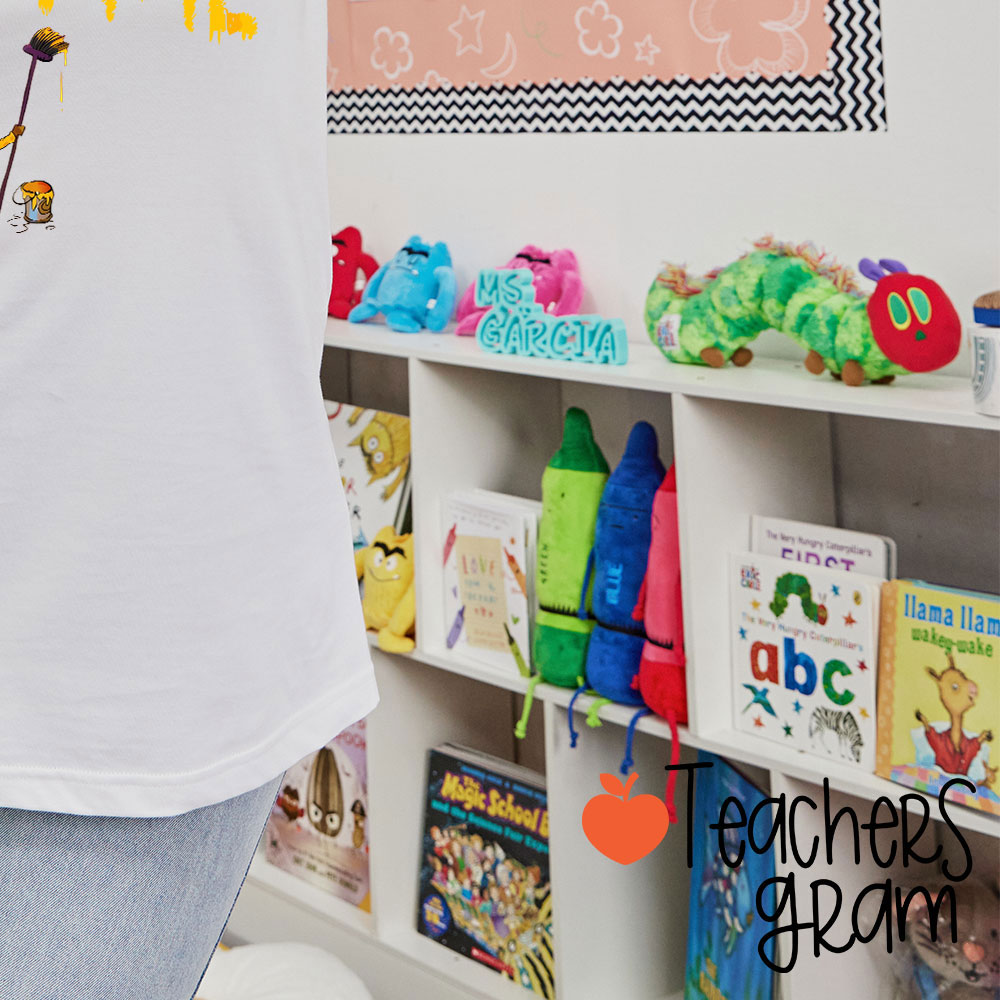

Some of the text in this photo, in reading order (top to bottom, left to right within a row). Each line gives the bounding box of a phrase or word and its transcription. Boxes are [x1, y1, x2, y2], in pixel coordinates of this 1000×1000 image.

[482, 313, 616, 359] GARCIA
[904, 593, 1000, 637] llama llam
[750, 637, 855, 706] abc
[441, 772, 486, 811] Magic
[487, 788, 541, 832] School
